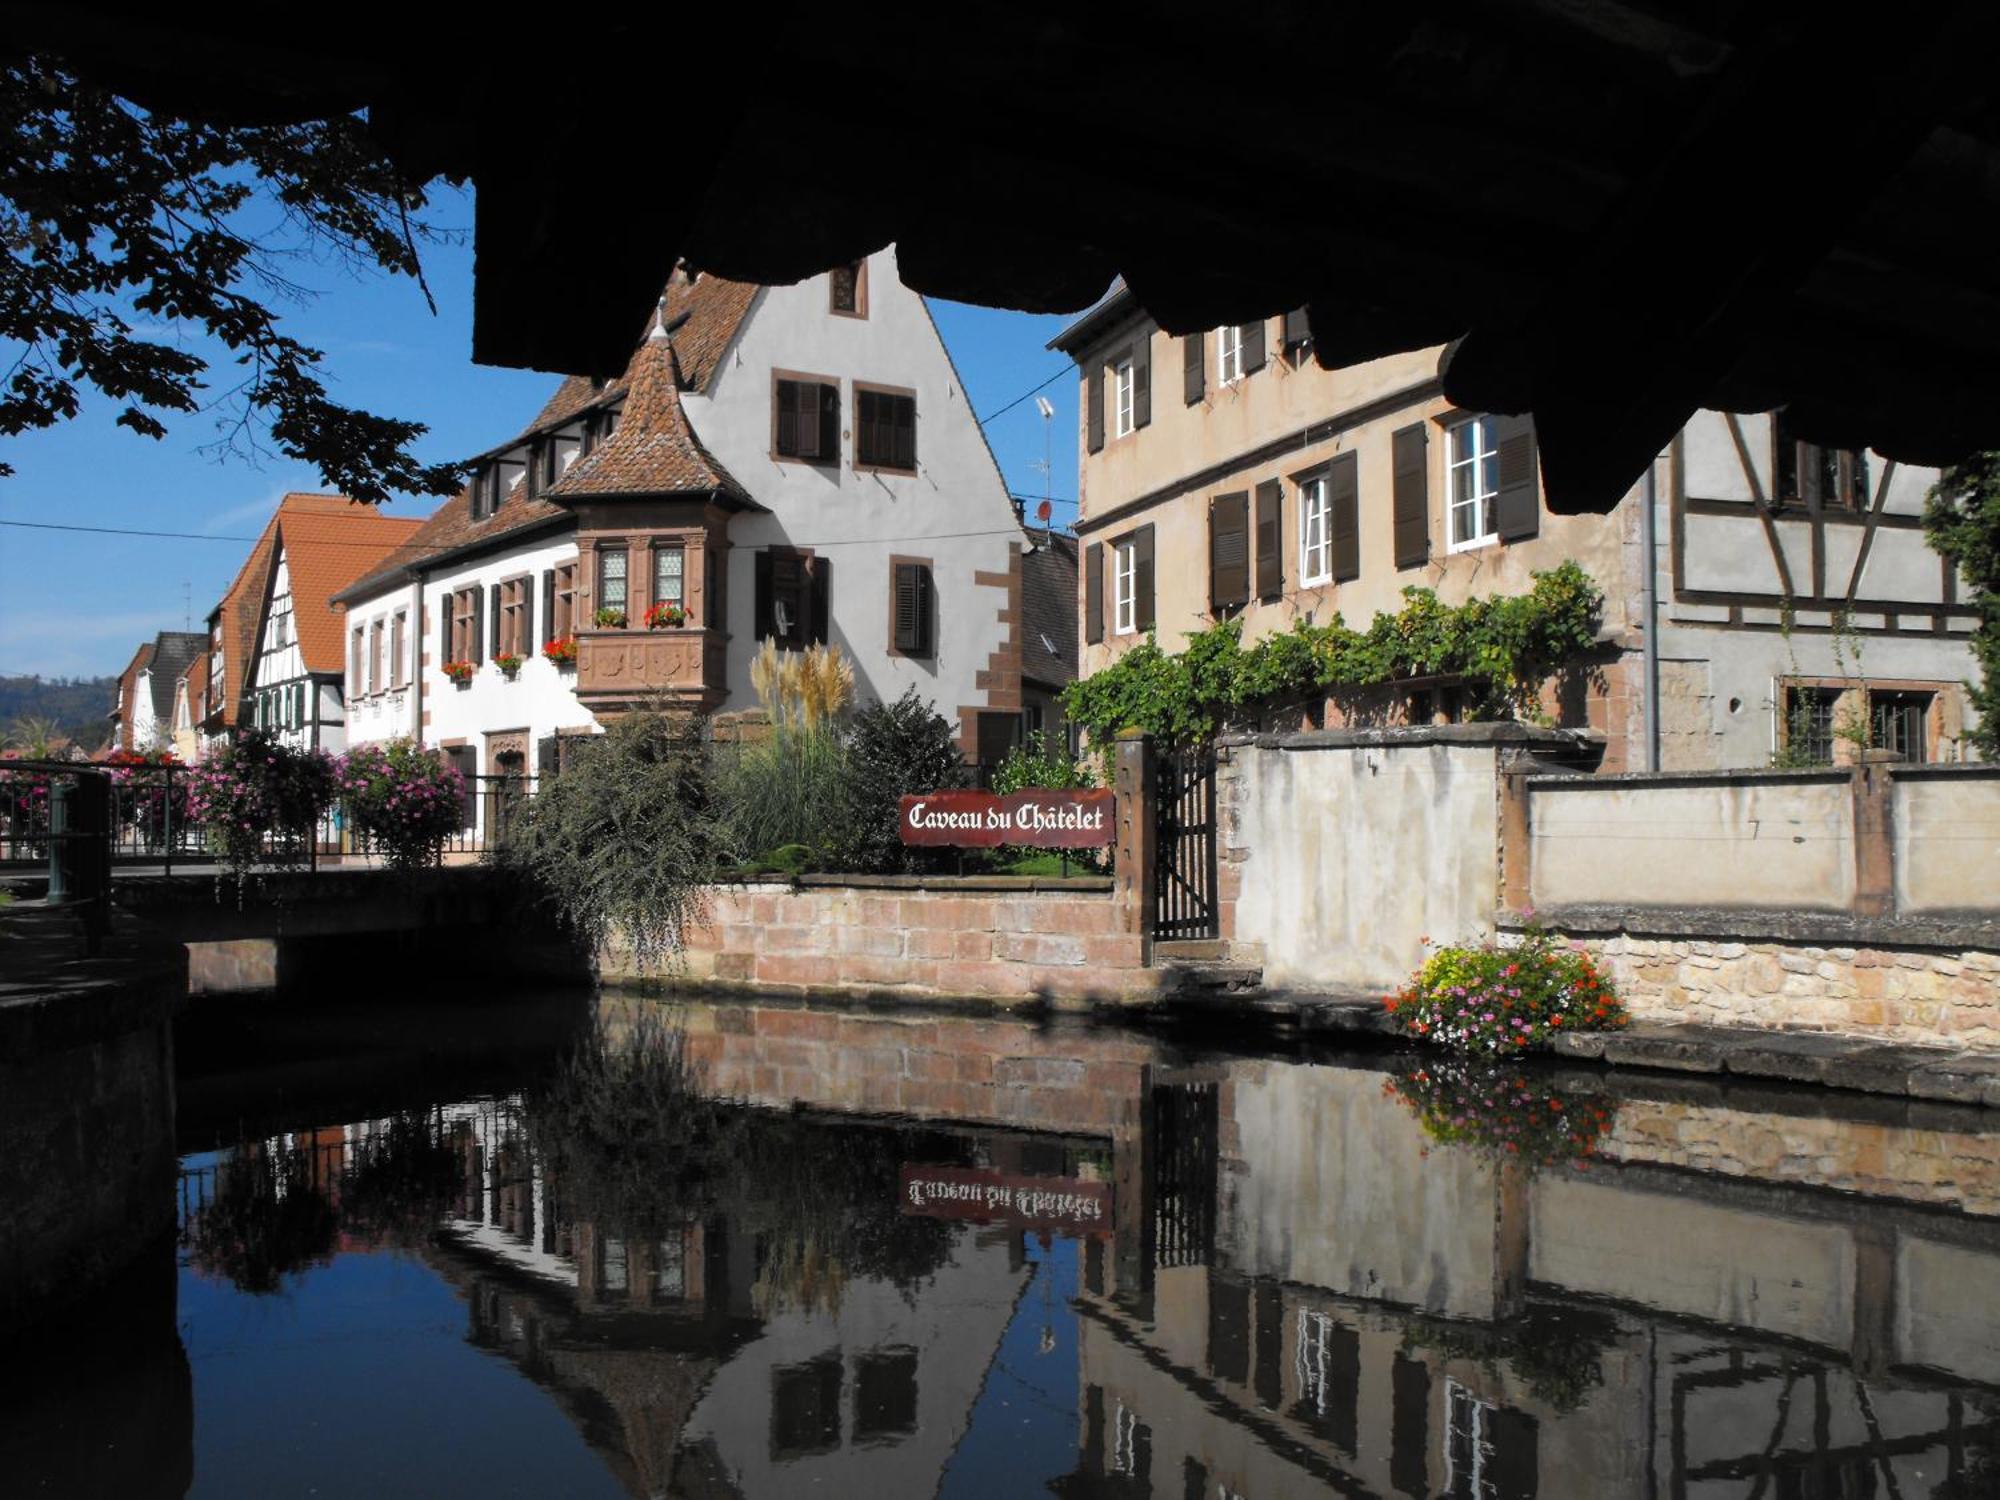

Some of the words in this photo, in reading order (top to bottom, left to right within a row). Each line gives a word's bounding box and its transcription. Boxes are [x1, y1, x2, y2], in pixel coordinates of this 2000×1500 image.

[909, 803, 981, 829] Caveau
[986, 806, 1011, 829] du
[1016, 803, 1103, 833] Châtelet
